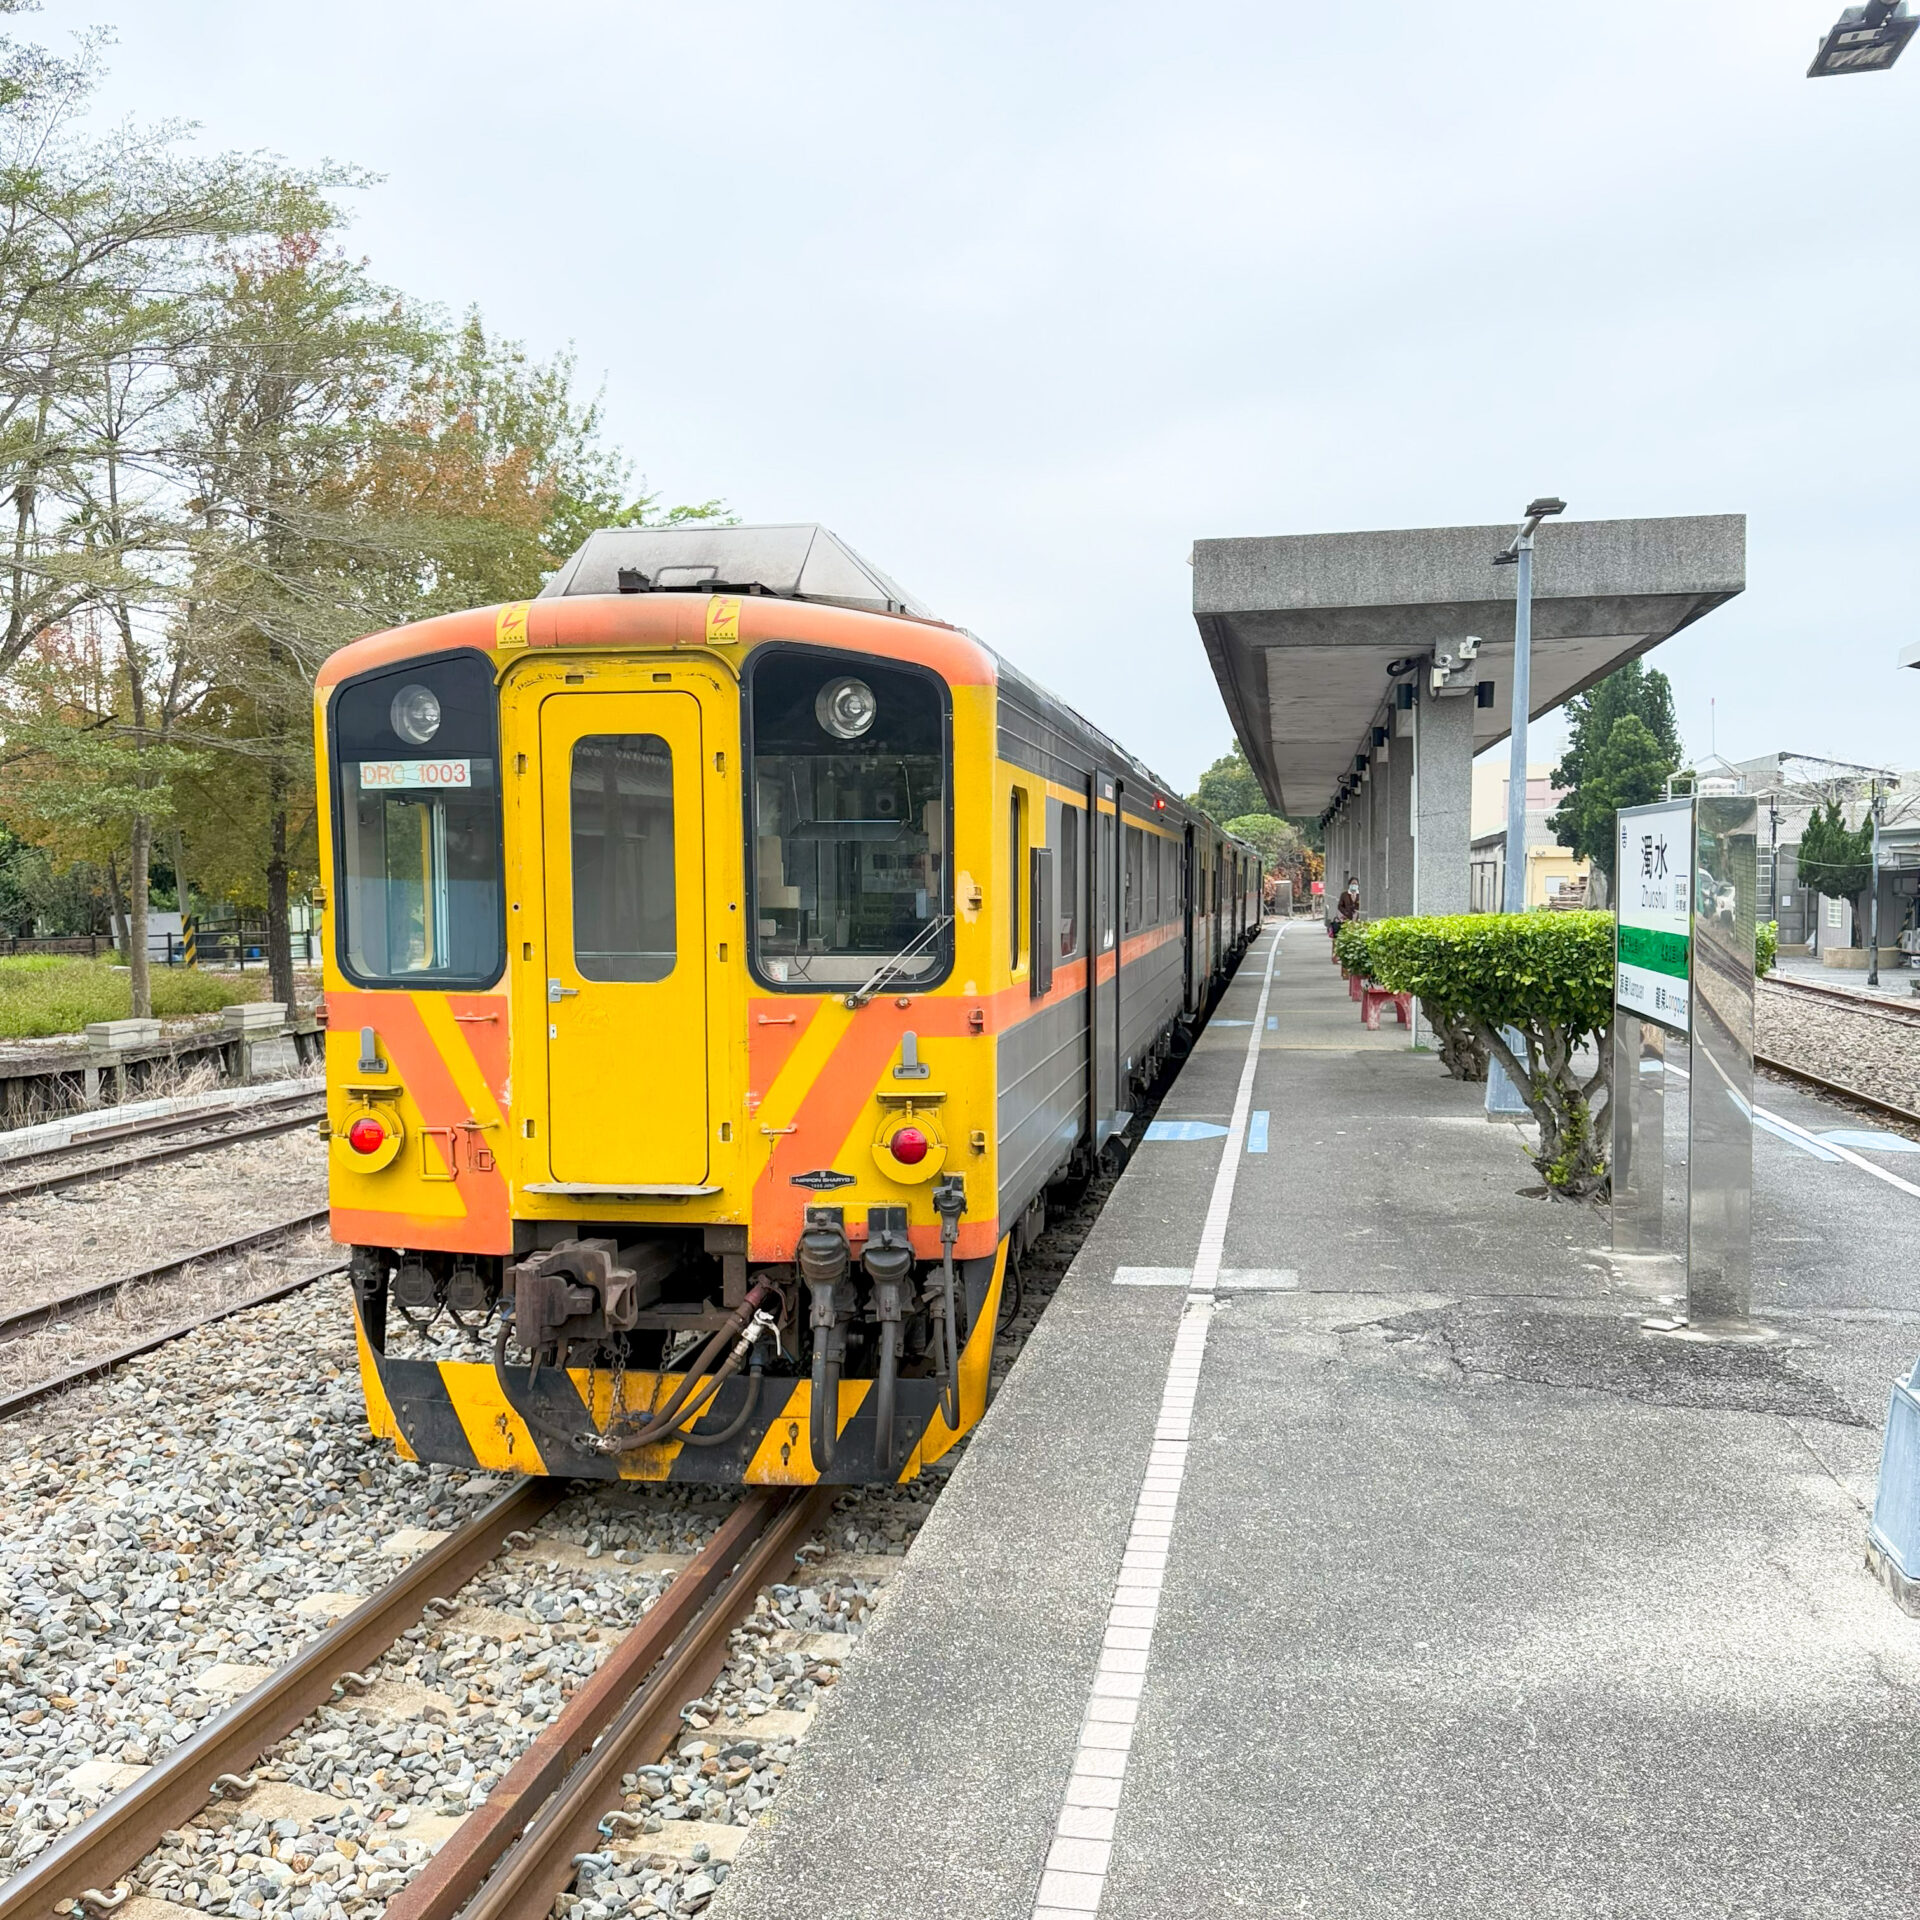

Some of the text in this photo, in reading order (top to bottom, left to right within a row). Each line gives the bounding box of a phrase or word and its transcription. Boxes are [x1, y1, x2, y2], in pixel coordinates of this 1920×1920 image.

[363, 763, 466, 785] DRC 1003
[1641, 833, 1668, 880] 濁水
